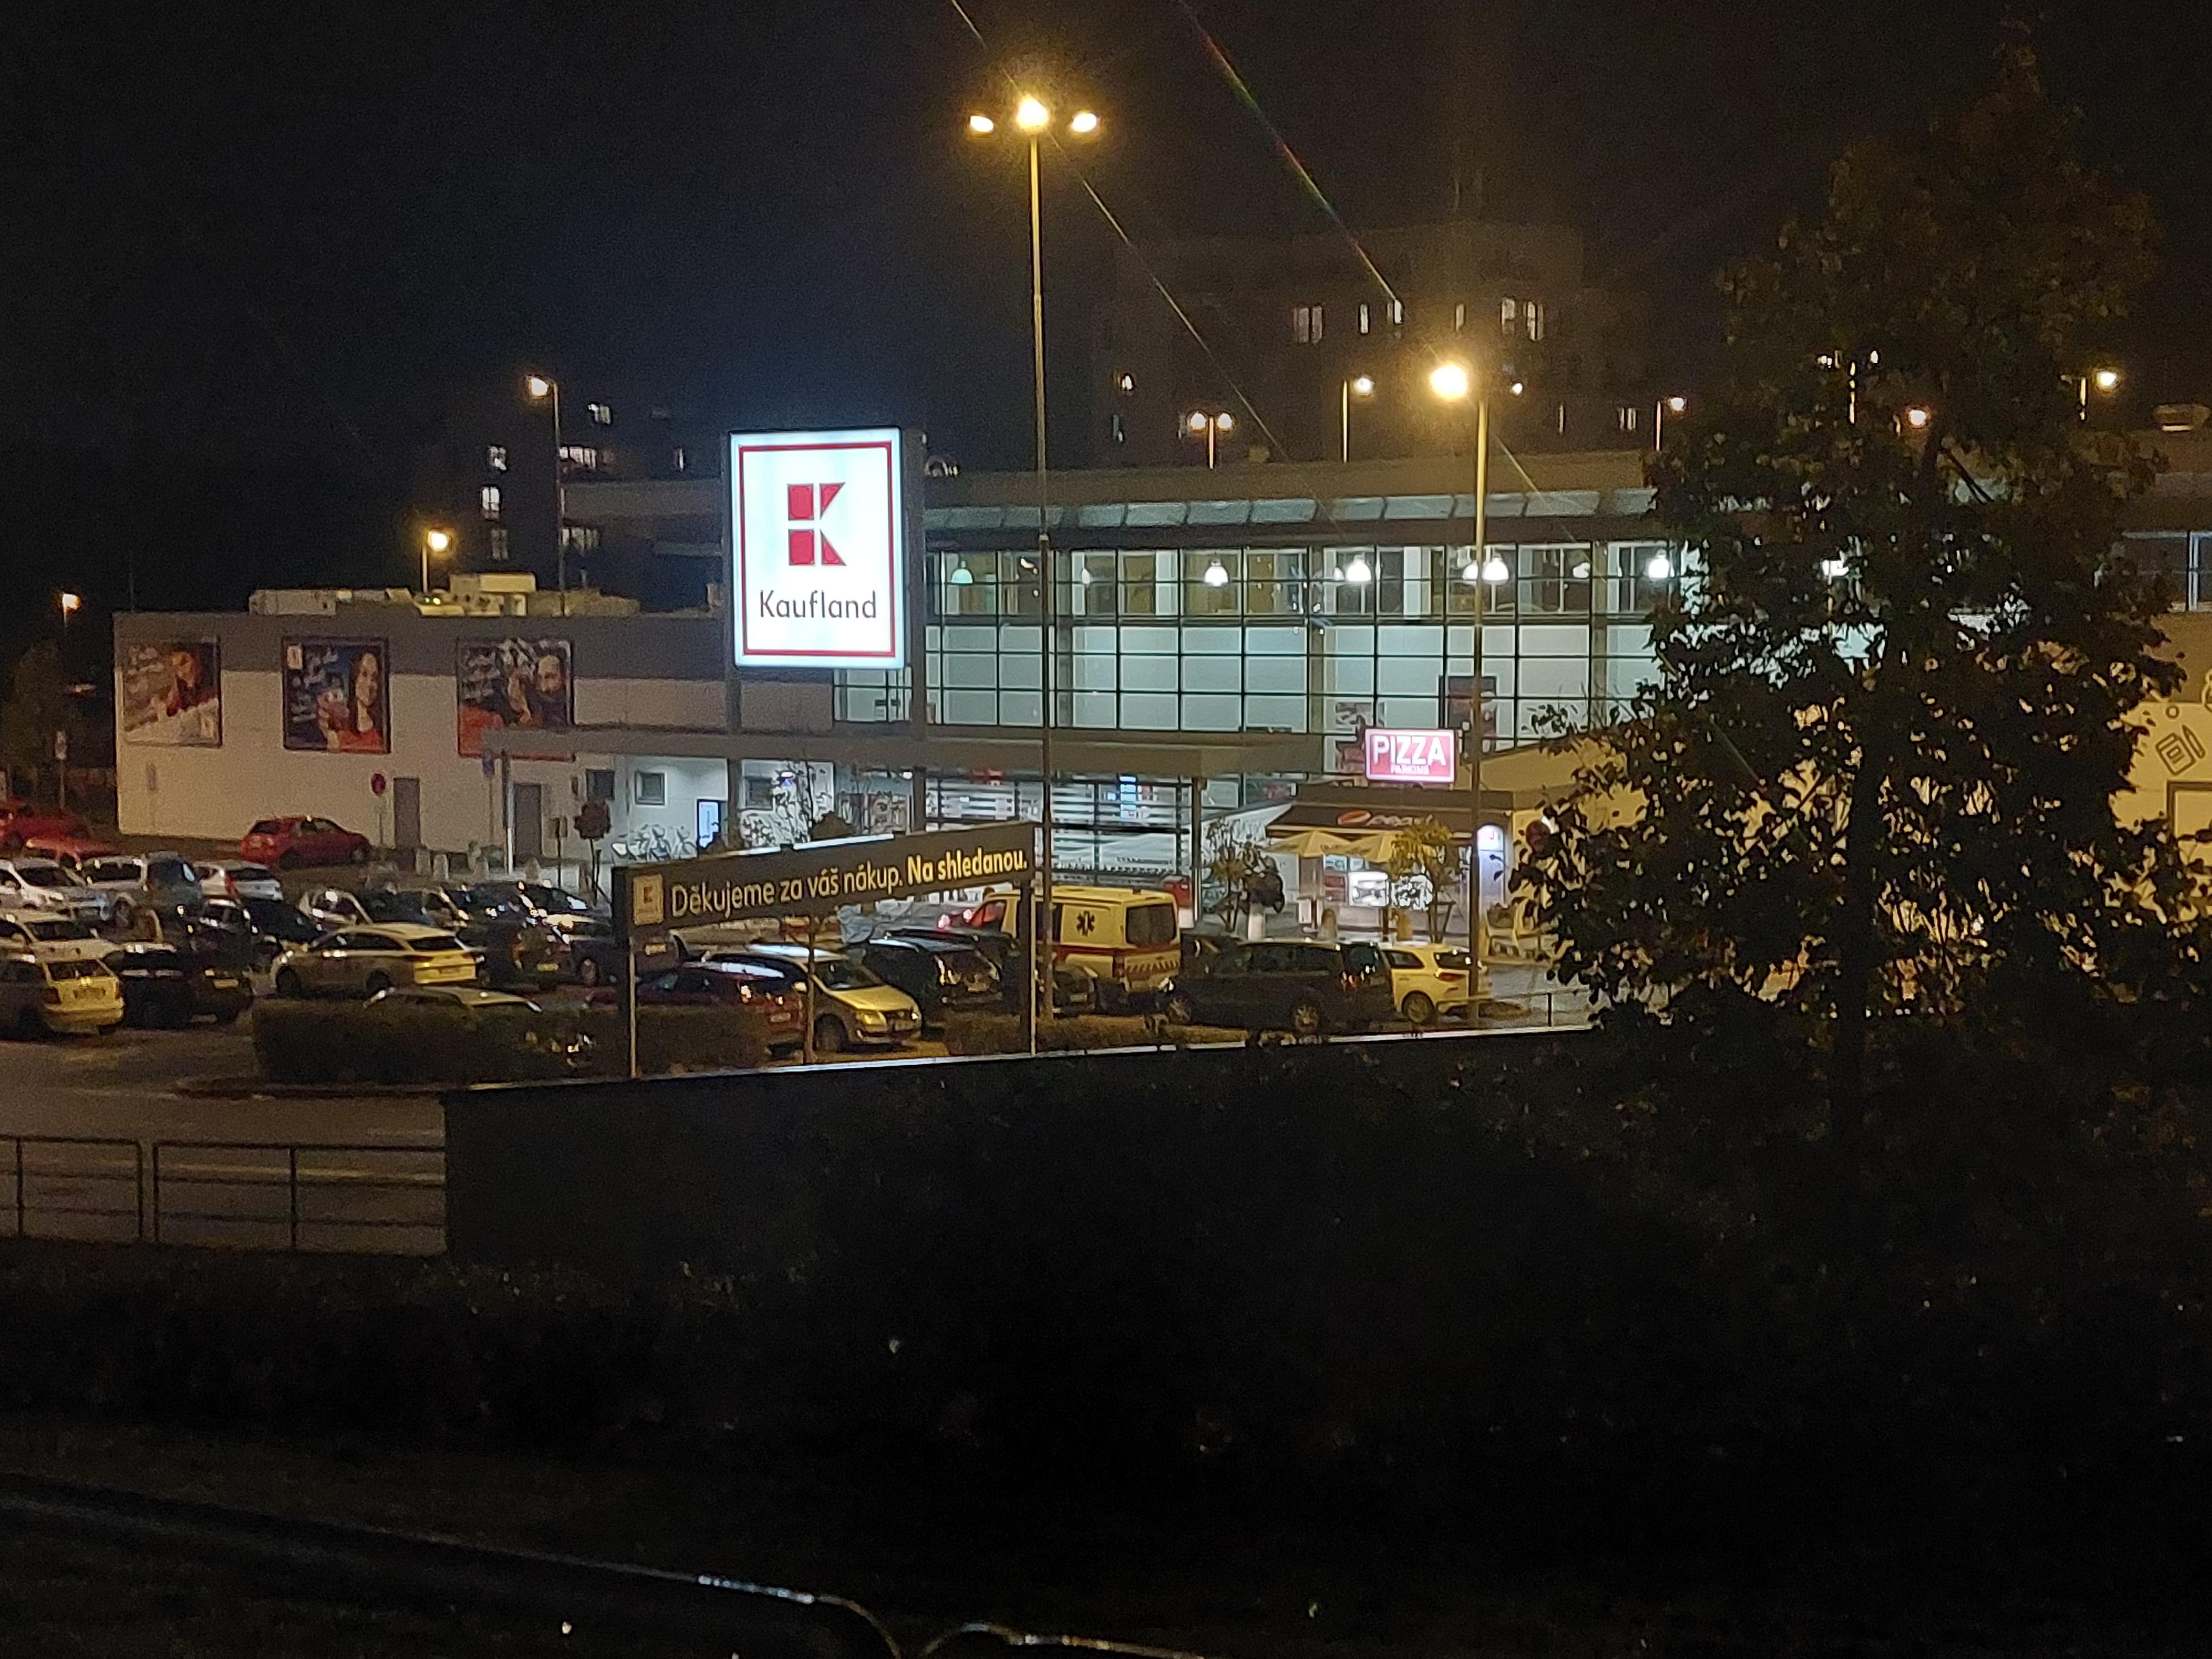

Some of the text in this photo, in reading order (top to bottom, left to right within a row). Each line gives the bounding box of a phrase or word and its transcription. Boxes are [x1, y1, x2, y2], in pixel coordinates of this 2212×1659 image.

[759, 589, 877, 619] Kaufland
[1373, 734, 1447, 766] PIZZA
[671, 847, 1027, 919] Děkujeme za váš nákup. Na shledanou.
